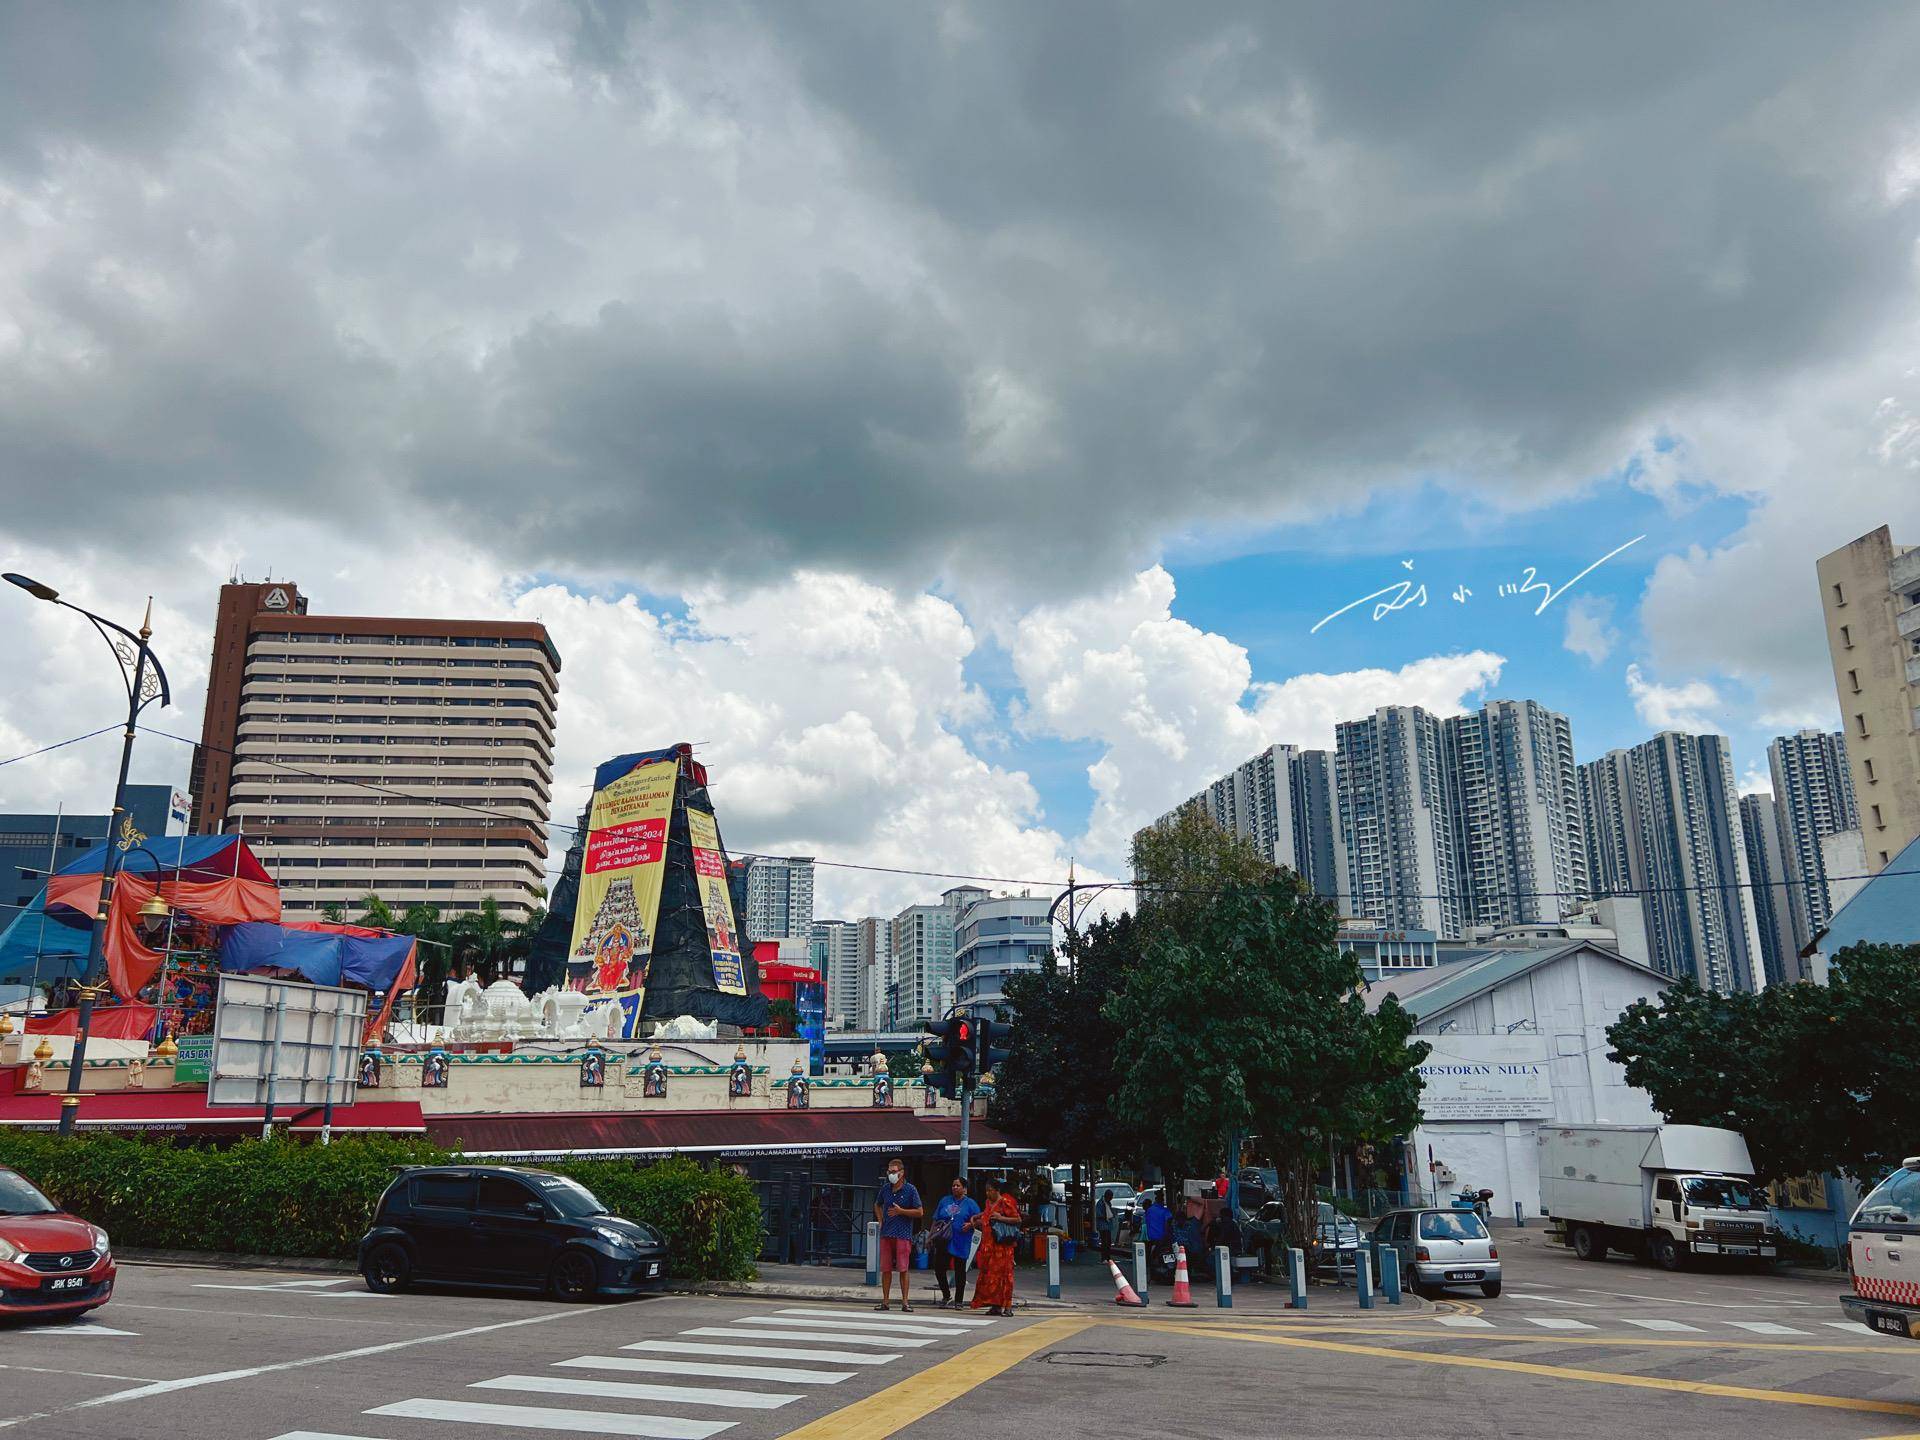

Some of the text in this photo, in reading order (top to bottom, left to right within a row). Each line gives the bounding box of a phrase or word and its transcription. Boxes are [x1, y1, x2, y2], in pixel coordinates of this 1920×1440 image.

[1420, 1065, 1539, 1075] RESTORAN NILLA
[720, 1149, 755, 1157] ARULMIGU
[755, 1148, 812, 1156] RAJAMARIAMMAN
[813, 1147, 859, 1155] DEVASTHANAM
[1714, 1221, 1755, 1229] DAIHATSU
